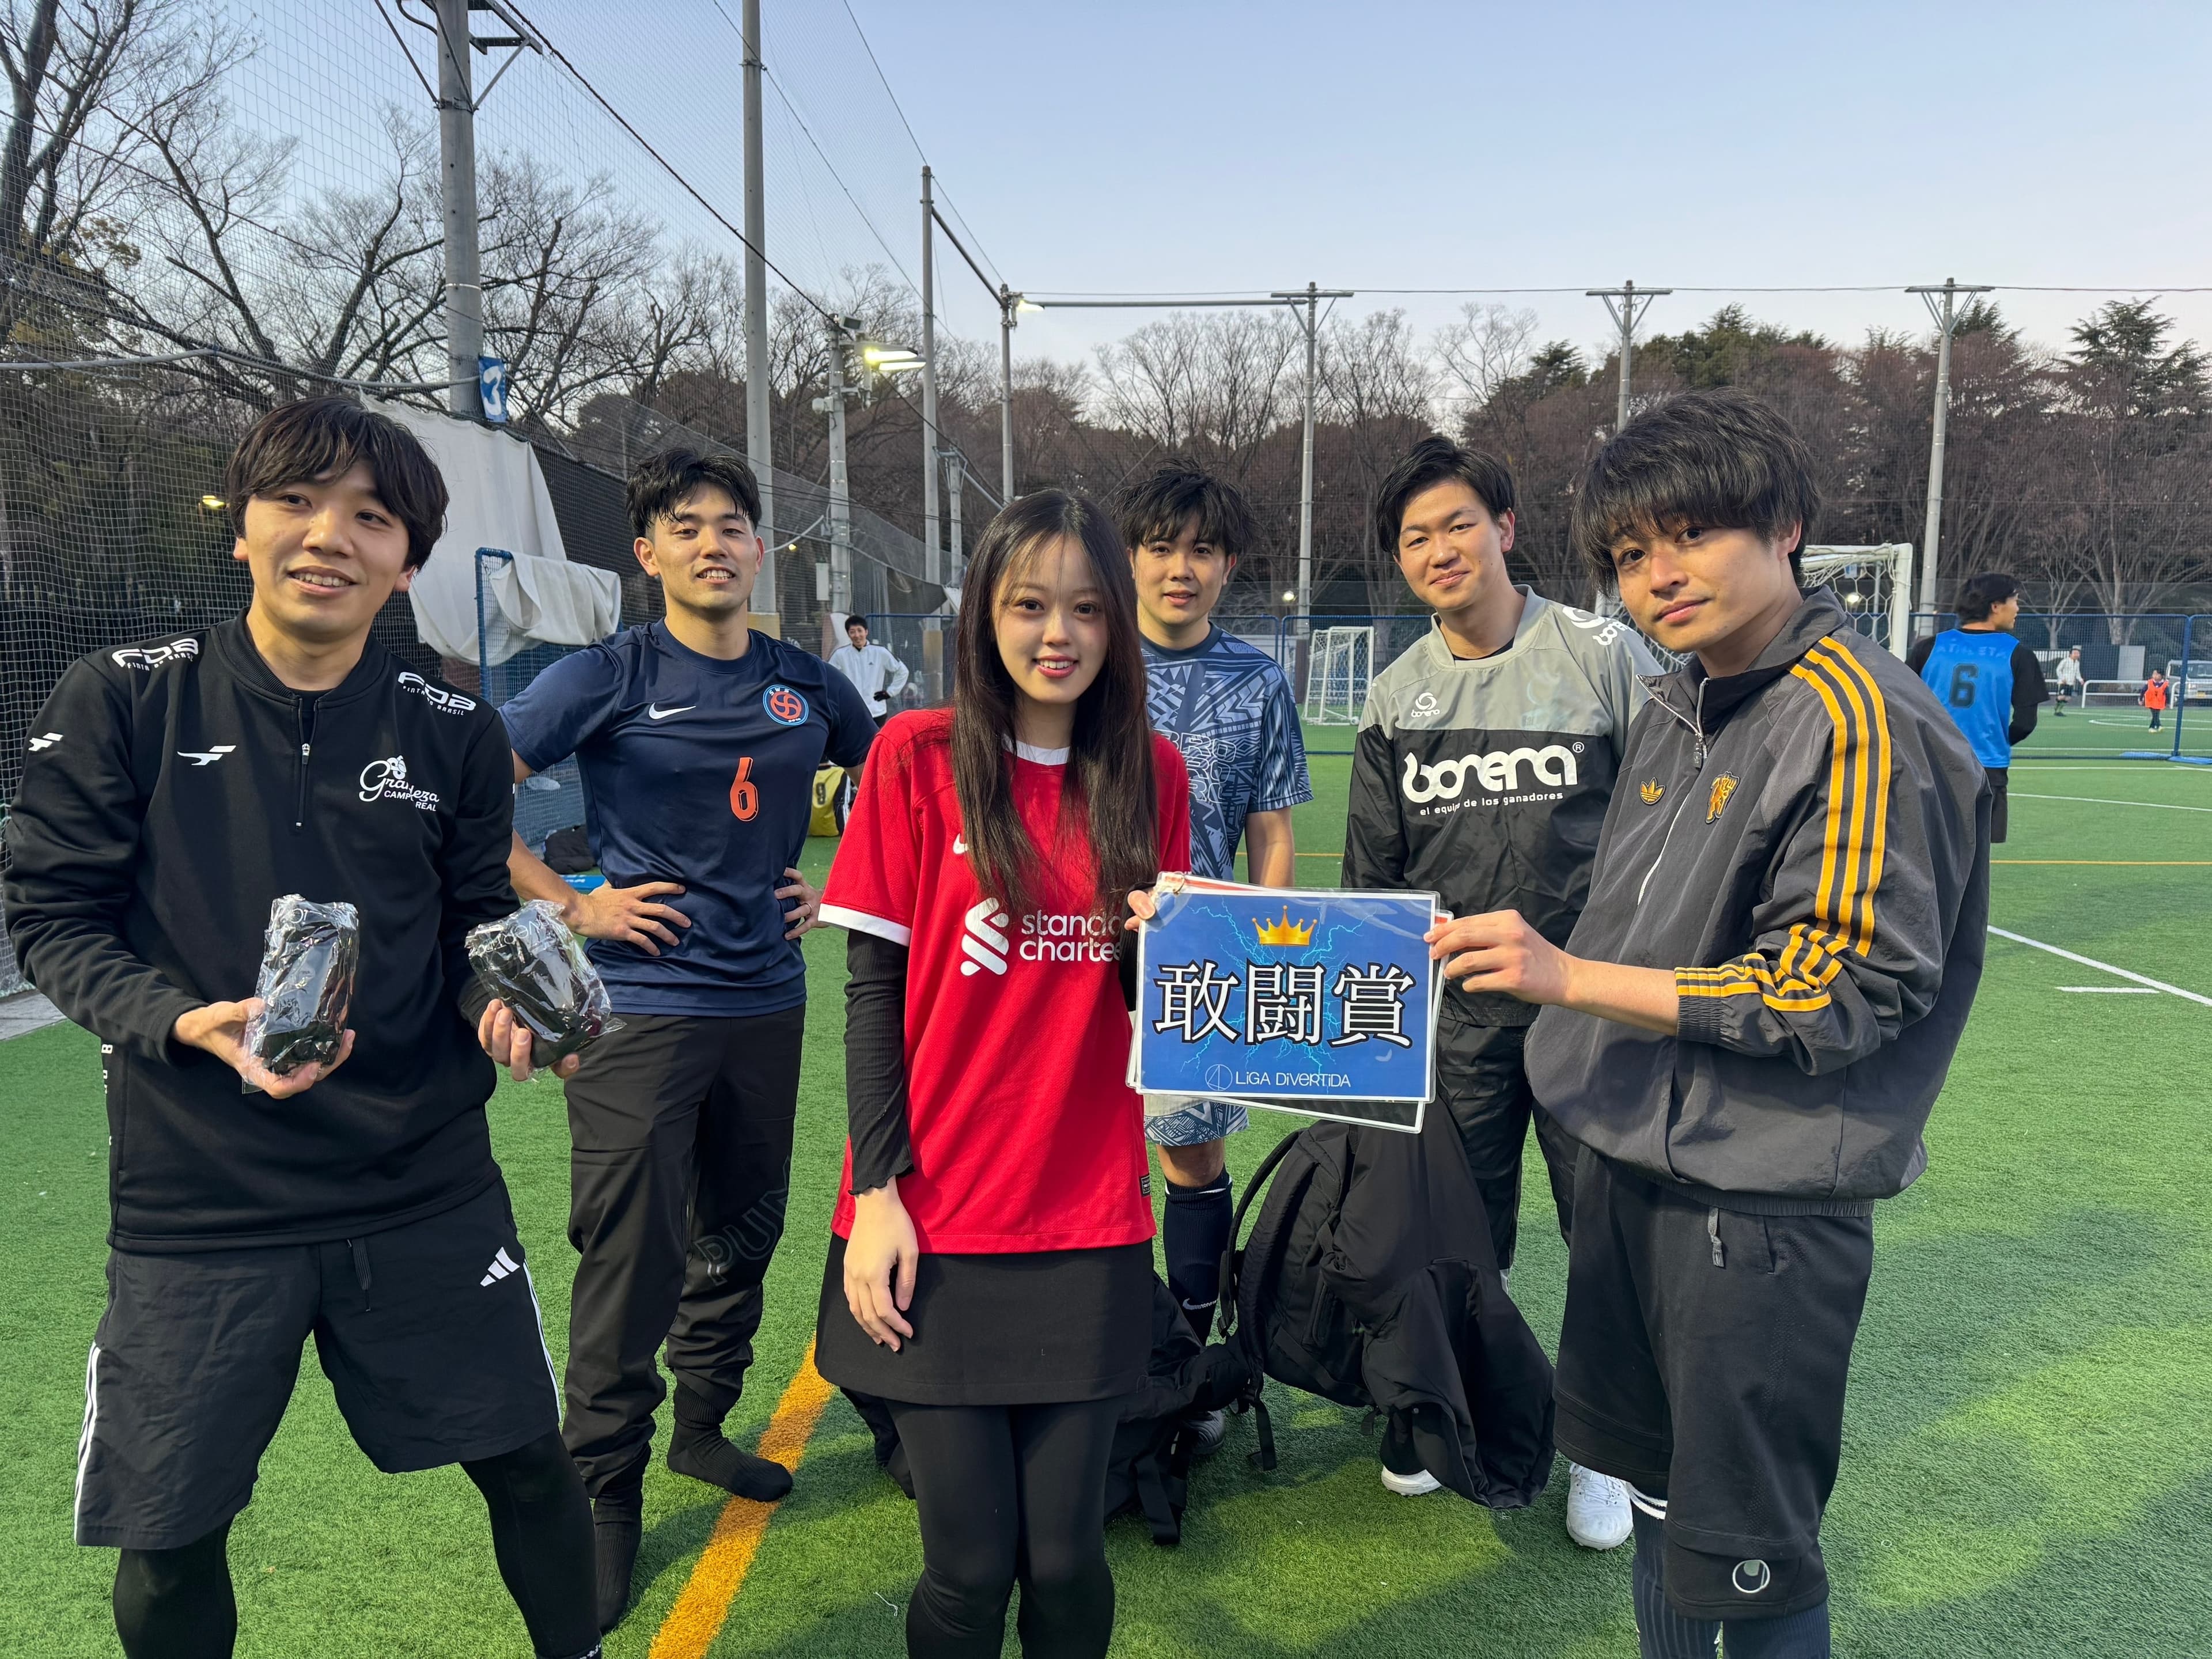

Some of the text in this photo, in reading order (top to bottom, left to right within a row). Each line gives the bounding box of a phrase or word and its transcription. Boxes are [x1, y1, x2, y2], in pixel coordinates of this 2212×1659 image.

[1949, 662, 1979, 710] 6
[415, 801, 437, 812] REAL
[730, 756, 759, 822] 6
[1420, 807, 1430, 816] el
[1464, 798, 1477, 808] de
[1482, 797, 1499, 806] los
[1503, 792, 1563, 806] ganadores
[1153, 959, 1416, 1048] 敢闘賞
